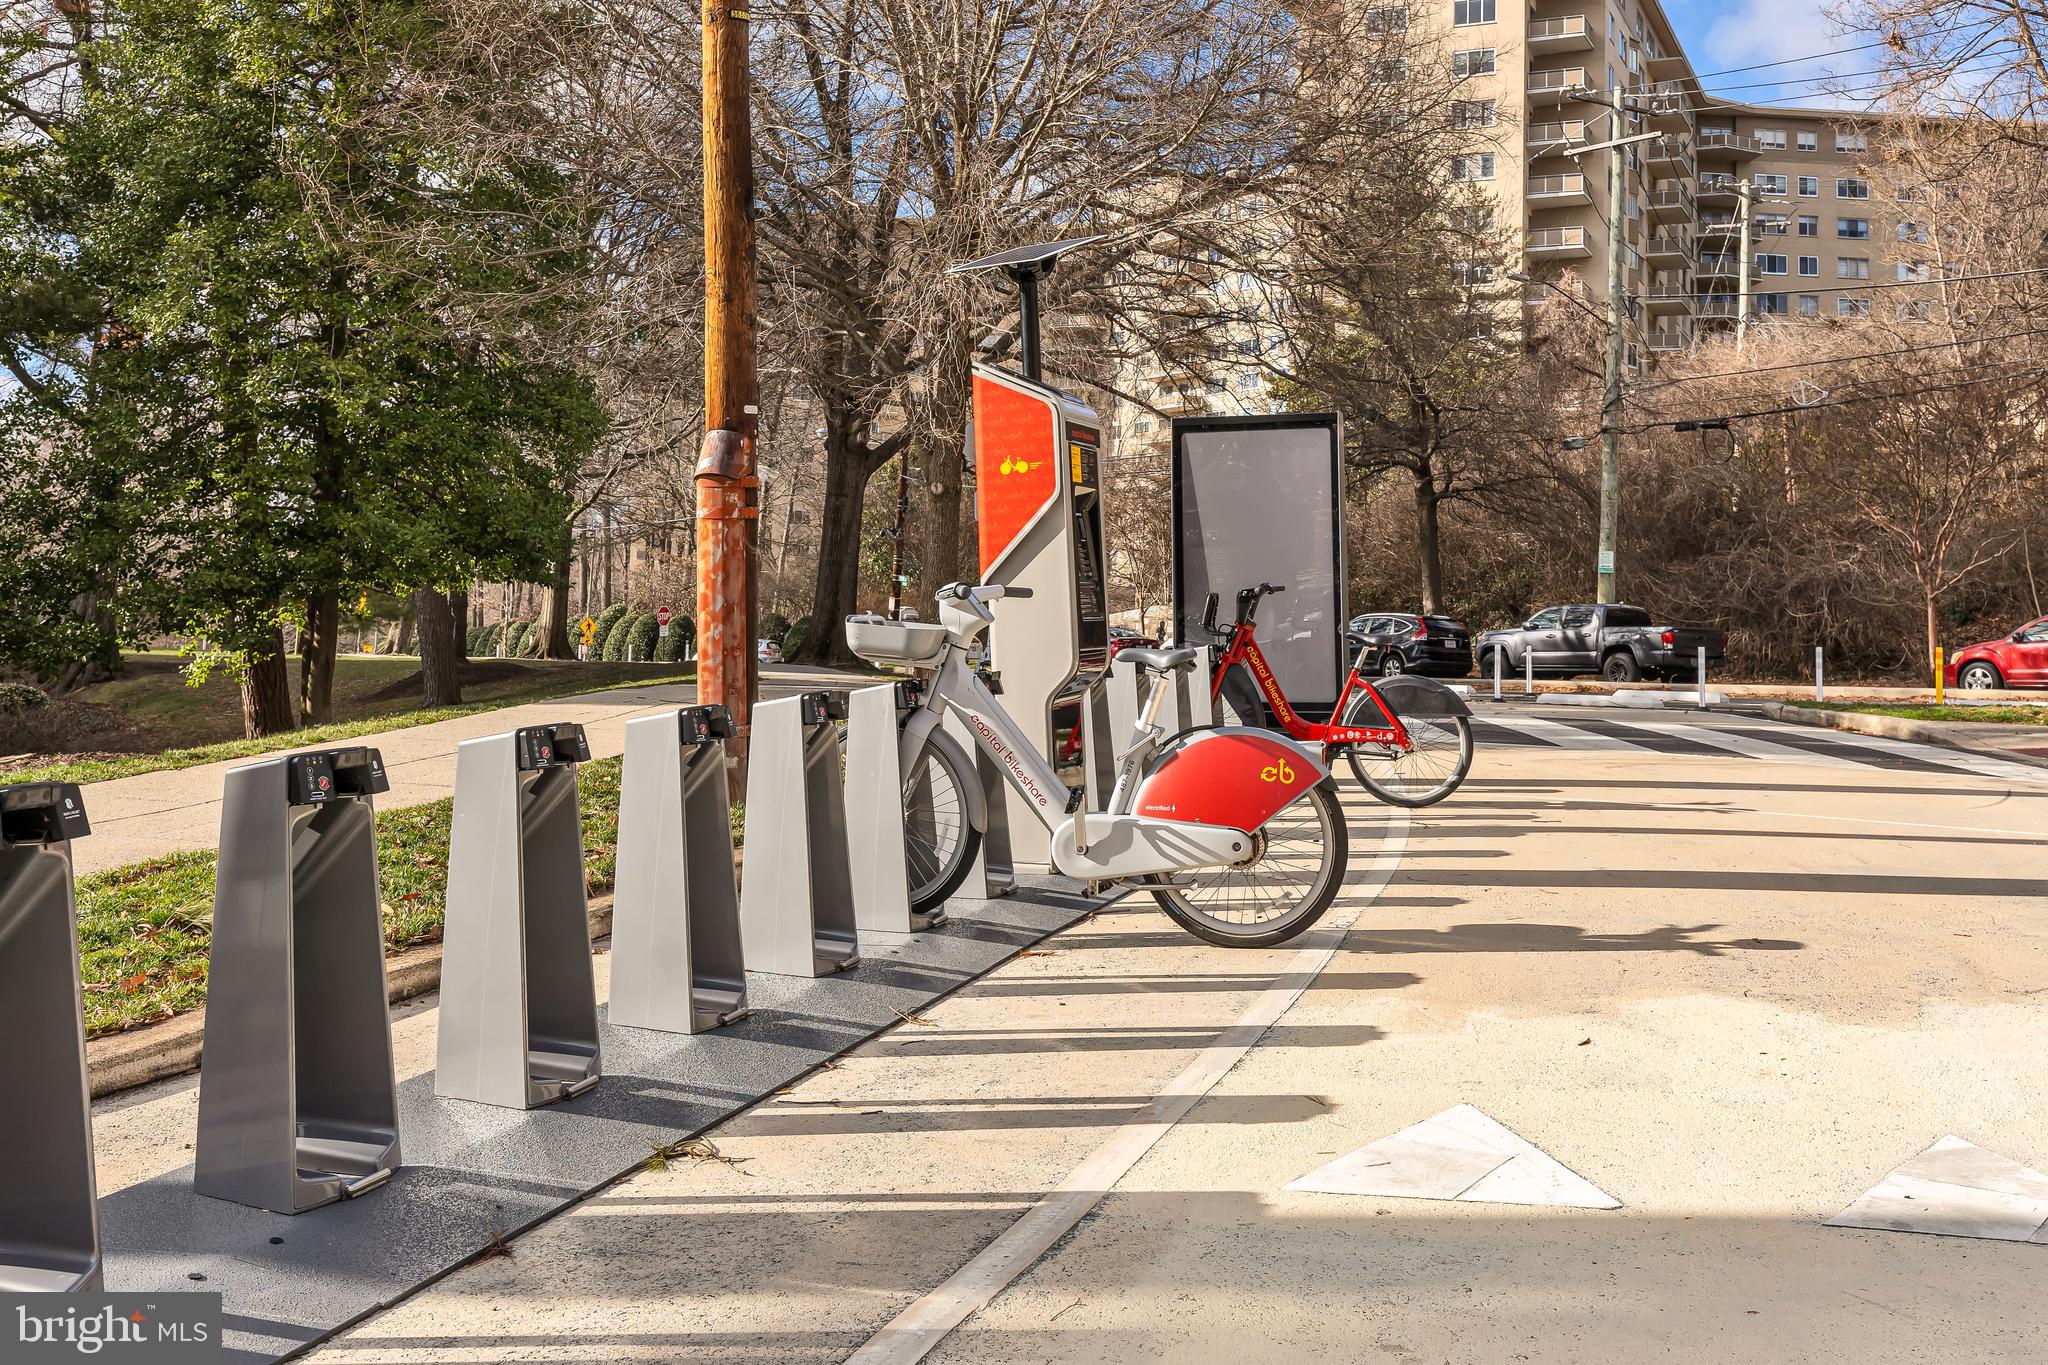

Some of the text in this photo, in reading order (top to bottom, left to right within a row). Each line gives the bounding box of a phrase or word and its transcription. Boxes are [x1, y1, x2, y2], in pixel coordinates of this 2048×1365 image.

[658, 612, 670, 621] STOP
[1247, 646, 1291, 723] capital bikeshare
[970, 714, 1047, 807] capital bikeshare
[1120, 760, 1135, 792] 487-1976
